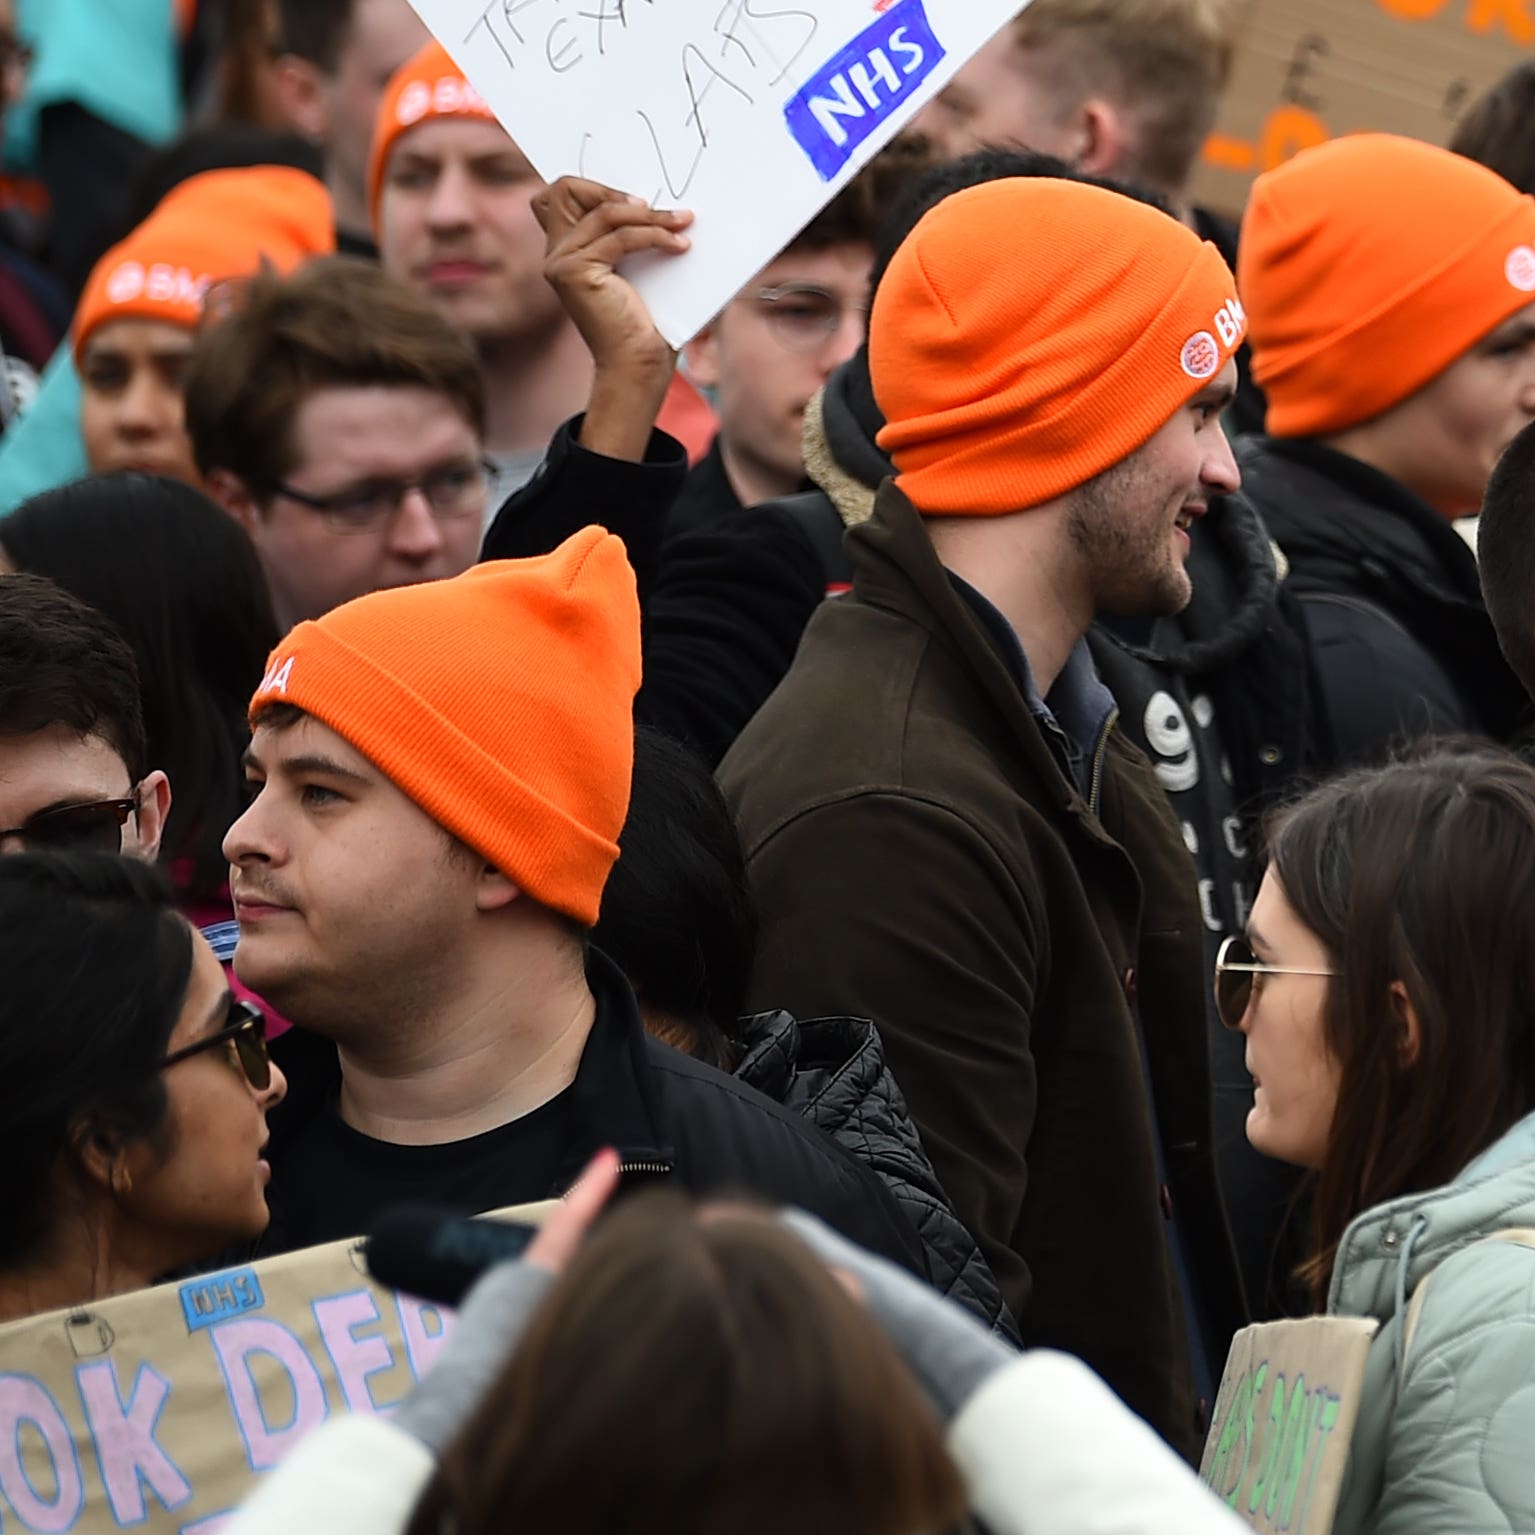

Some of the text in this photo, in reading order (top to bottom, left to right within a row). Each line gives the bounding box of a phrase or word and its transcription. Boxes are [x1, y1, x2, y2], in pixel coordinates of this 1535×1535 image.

[807, 26, 924, 147] NHS
[190, 1275, 260, 1319] NHS
[0, 1352, 192, 1534] OK
